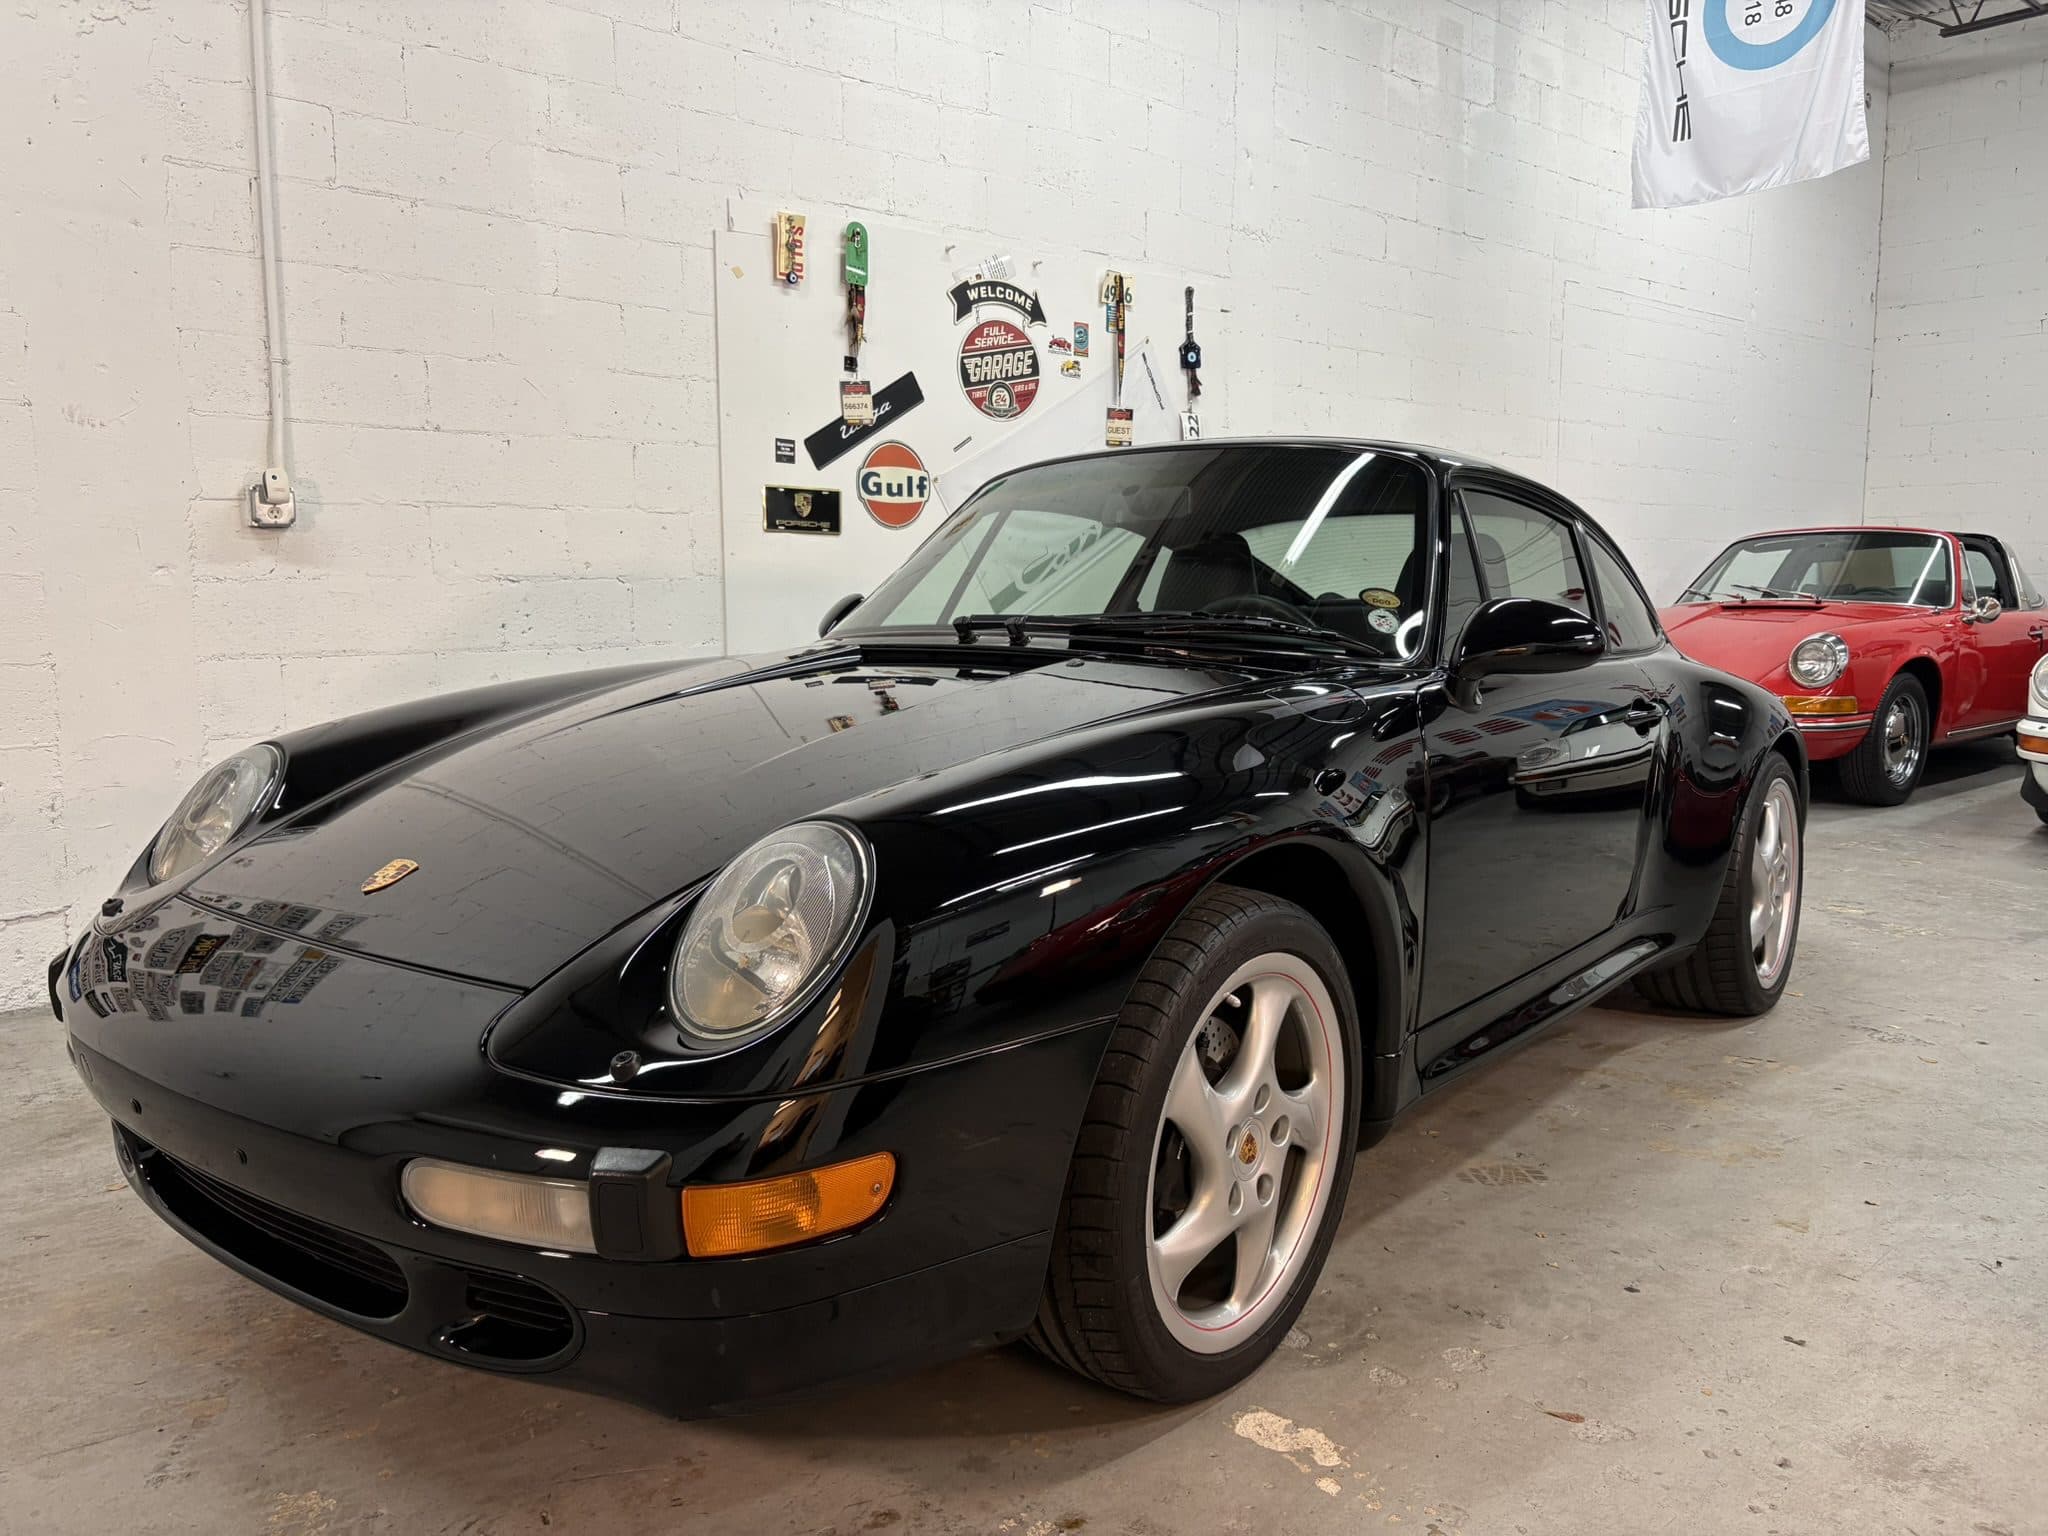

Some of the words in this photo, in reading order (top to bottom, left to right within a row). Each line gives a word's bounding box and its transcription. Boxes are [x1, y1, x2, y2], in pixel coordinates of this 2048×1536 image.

[966, 286, 1033, 311] WELCOME
[983, 326, 1007, 337] FULL
[975, 333, 1014, 348] SERVICE
[963, 350, 1034, 382] GARAGE
[994, 394, 1007, 404] 24
[1107, 426, 1131, 435] GUEST
[861, 472, 928, 498] Gulf
